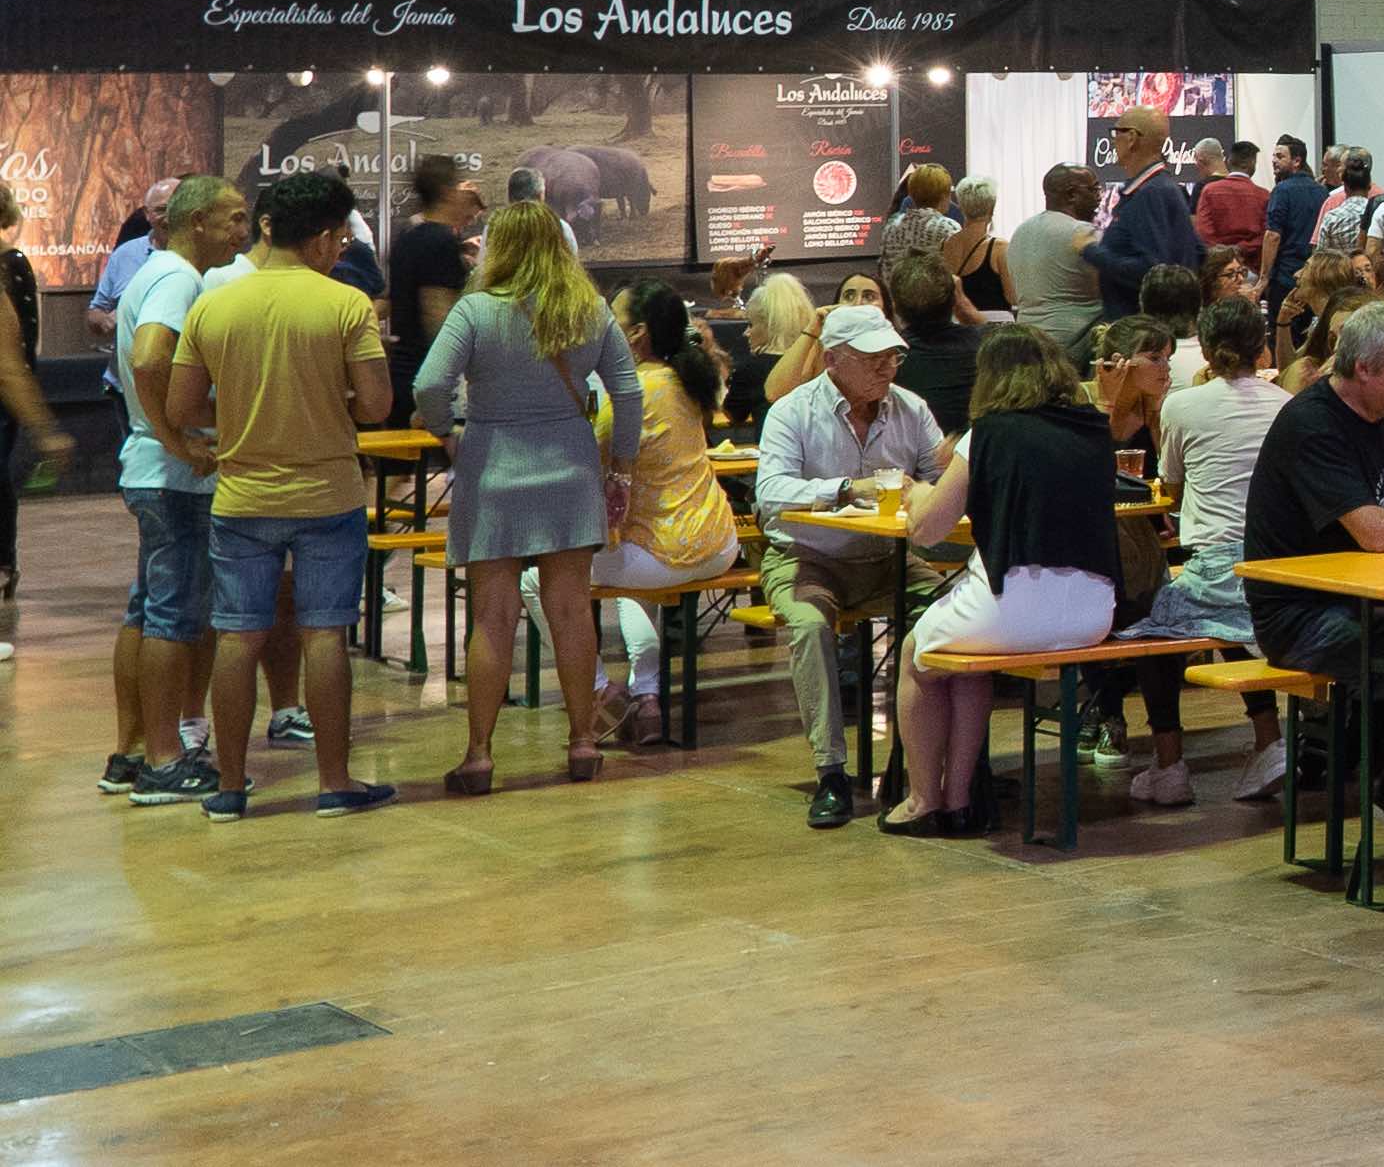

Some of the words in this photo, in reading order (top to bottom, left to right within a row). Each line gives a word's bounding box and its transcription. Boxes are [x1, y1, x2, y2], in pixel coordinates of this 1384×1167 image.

[340, 3, 372, 25] del
[847, 7, 906, 31] Desde
[911, 12, 955, 31] 1985
[776, 83, 804, 102] Los
[808, 82, 888, 103] Andaluces
[0, 144, 58, 181] os
[258, 143, 315, 176] Los
